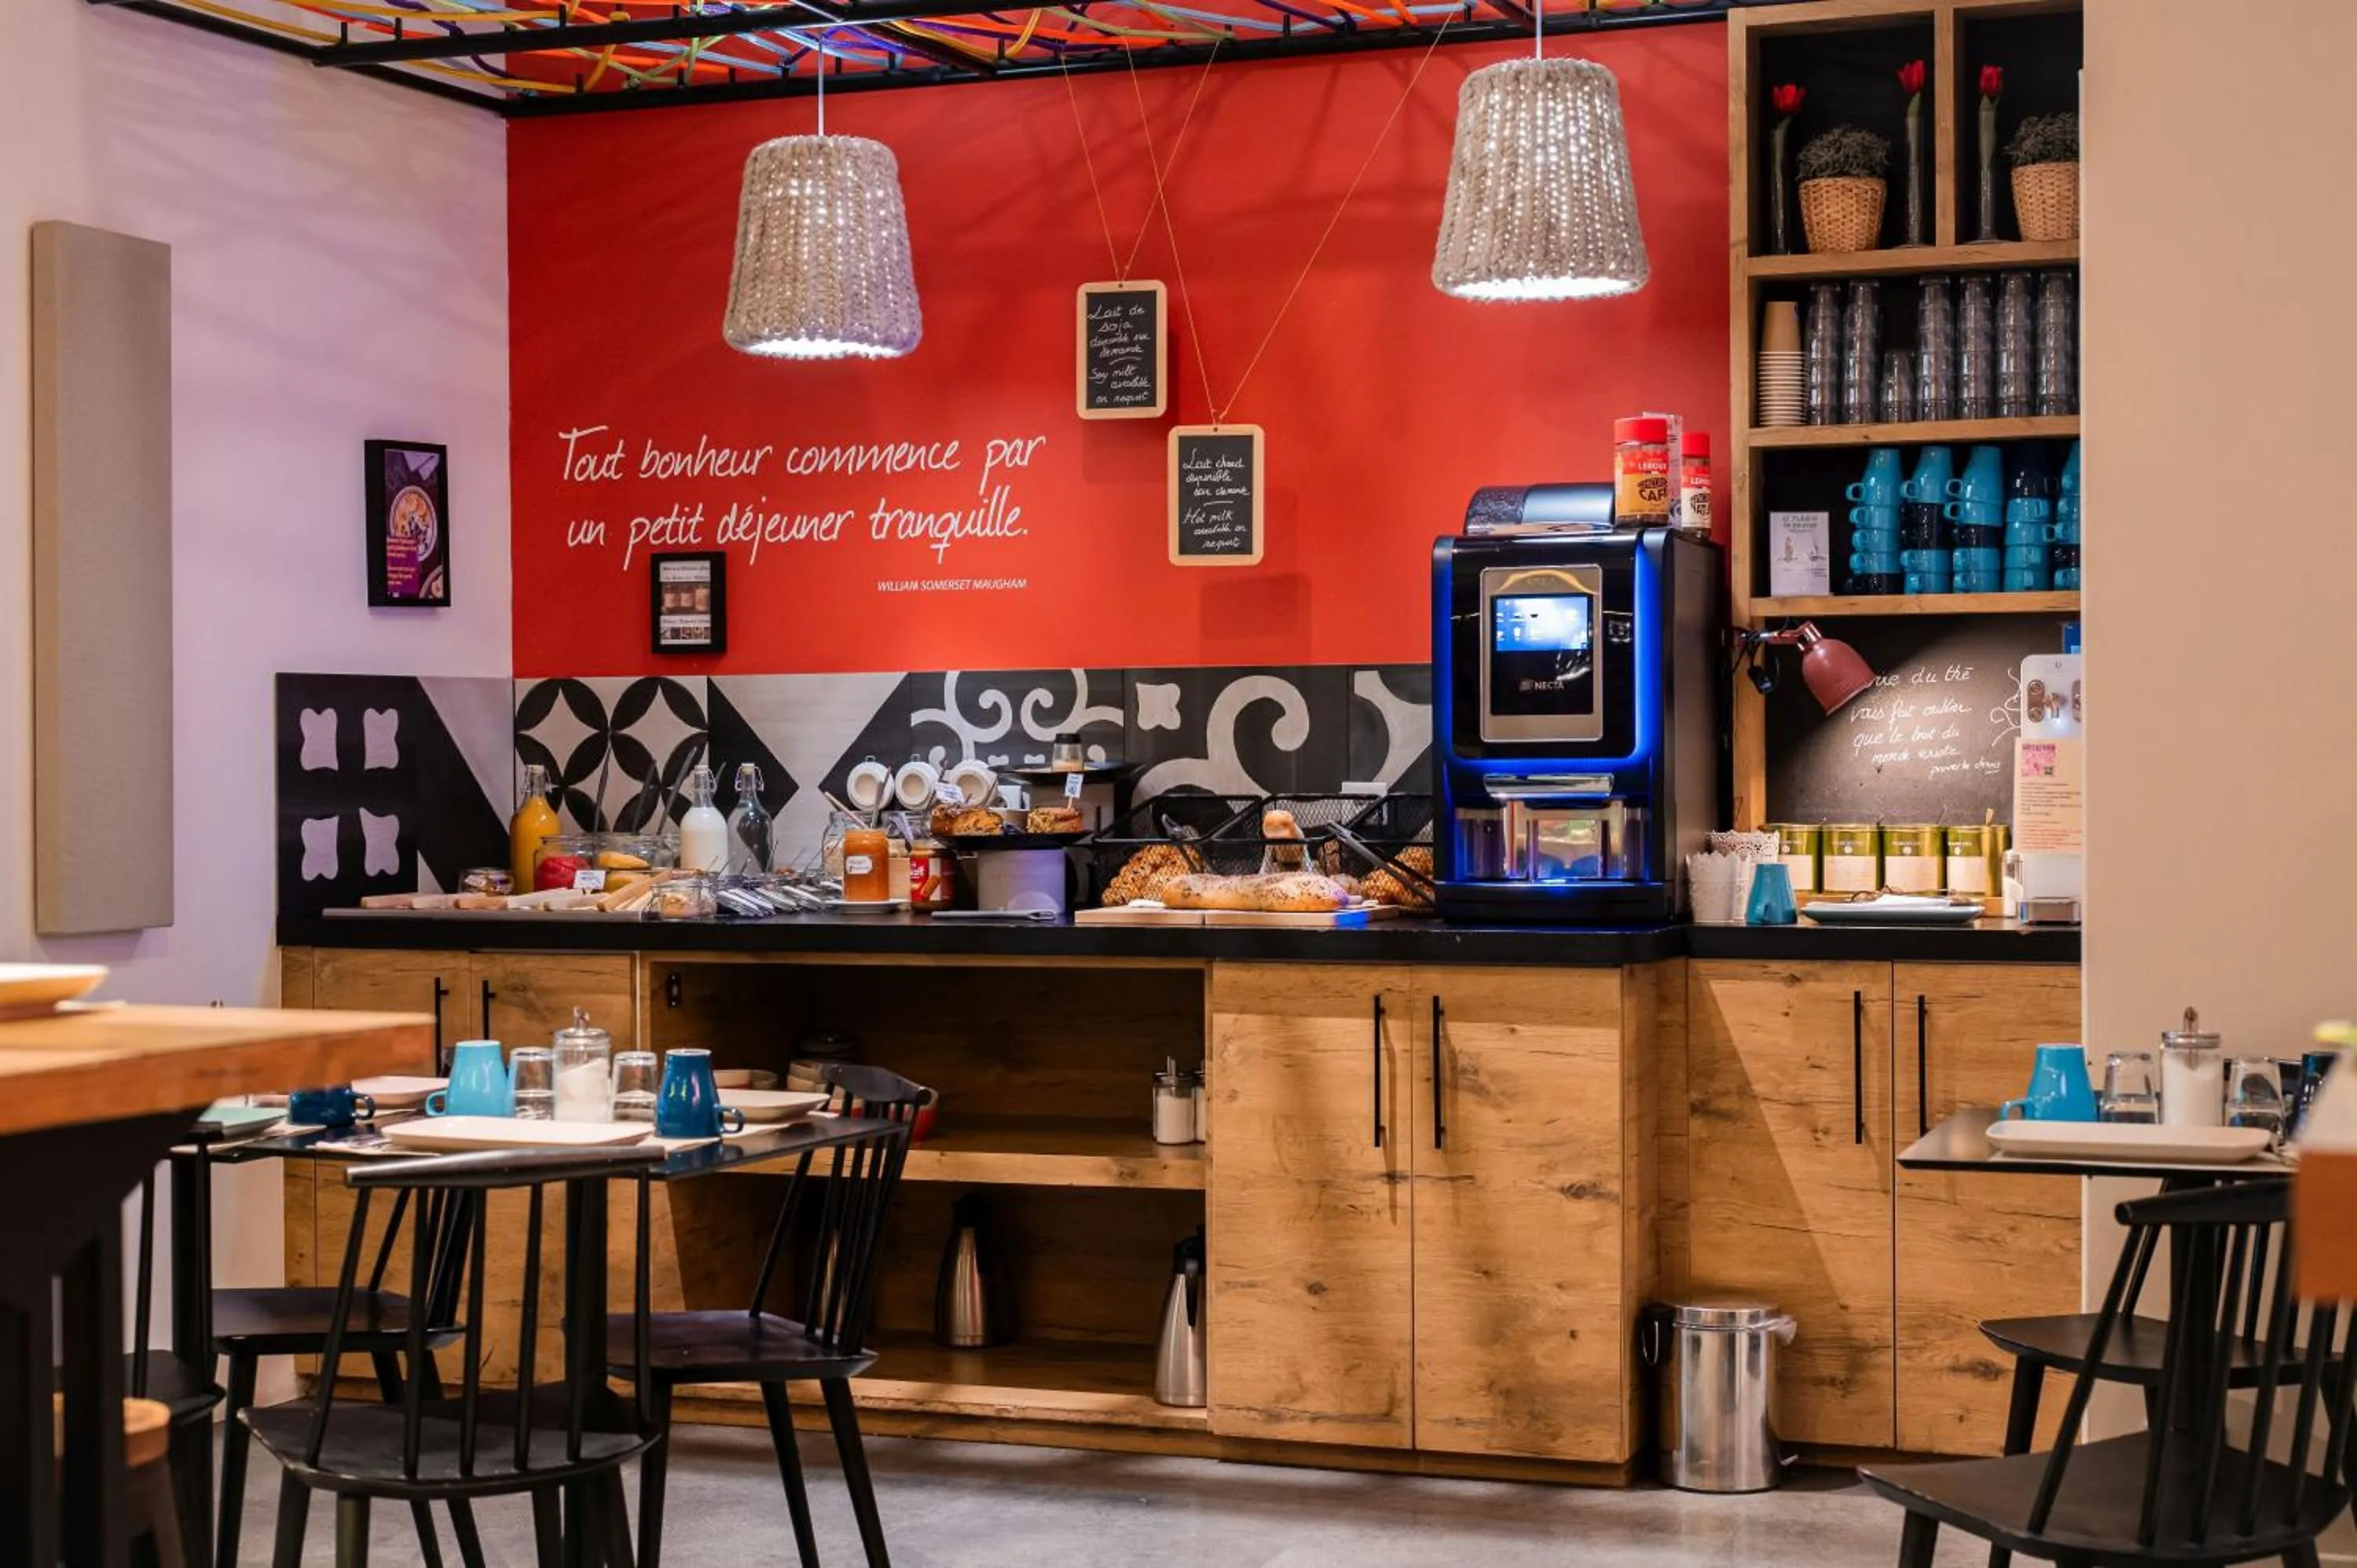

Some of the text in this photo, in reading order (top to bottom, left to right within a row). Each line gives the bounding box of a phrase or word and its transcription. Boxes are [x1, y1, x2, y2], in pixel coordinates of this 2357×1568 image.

[559, 425, 1047, 496] Tout bonheur commence par
[567, 485, 1028, 571] un petit déjeuner tranquille.
[877, 577, 1028, 592] WILLIAM SOMERSET MAUGHAM
[1534, 680, 1565, 691] NECTA
